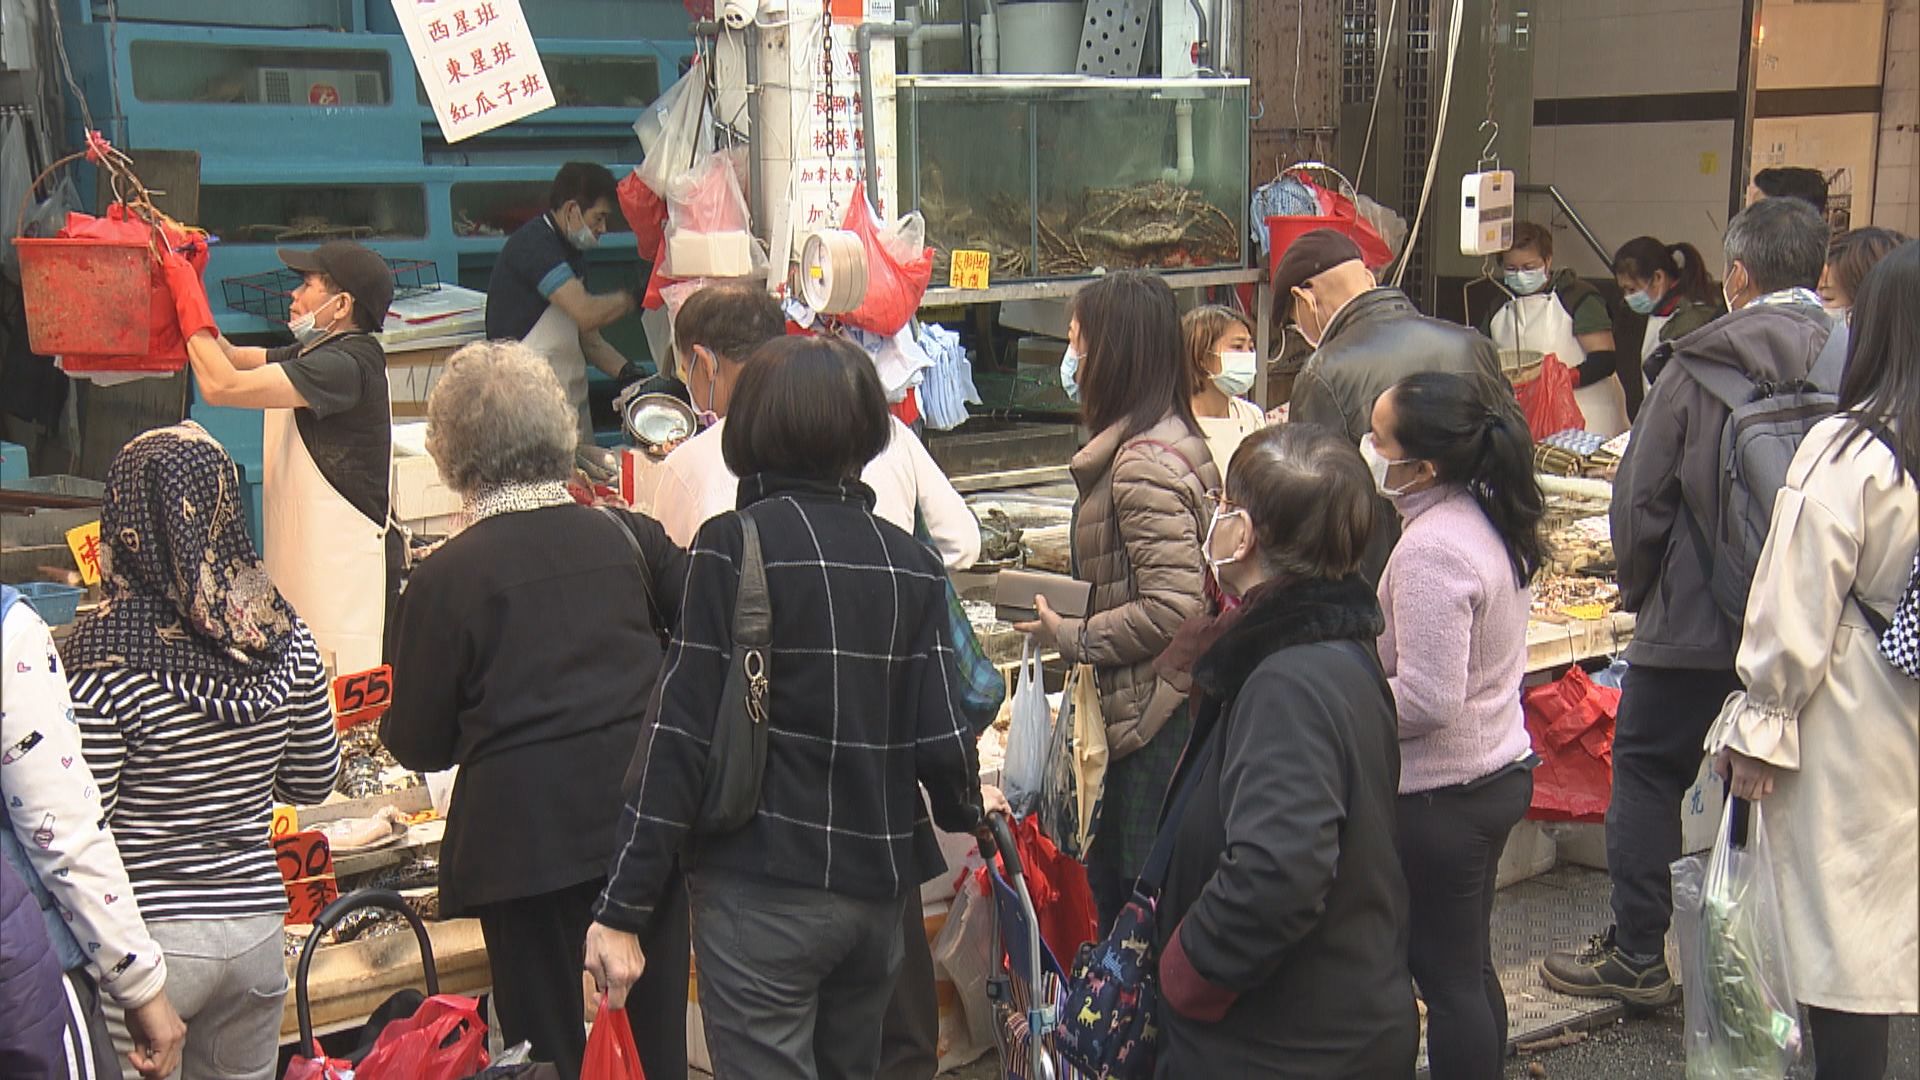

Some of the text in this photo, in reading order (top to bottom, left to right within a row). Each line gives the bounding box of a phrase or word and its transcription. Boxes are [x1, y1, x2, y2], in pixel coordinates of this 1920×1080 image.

[428, 2, 500, 43] 西星班
[446, 41, 516, 85] 東星班
[450, 73, 544, 125] 紅瓜子班
[343, 671, 390, 711] 55
[273, 837, 331, 881] 50
